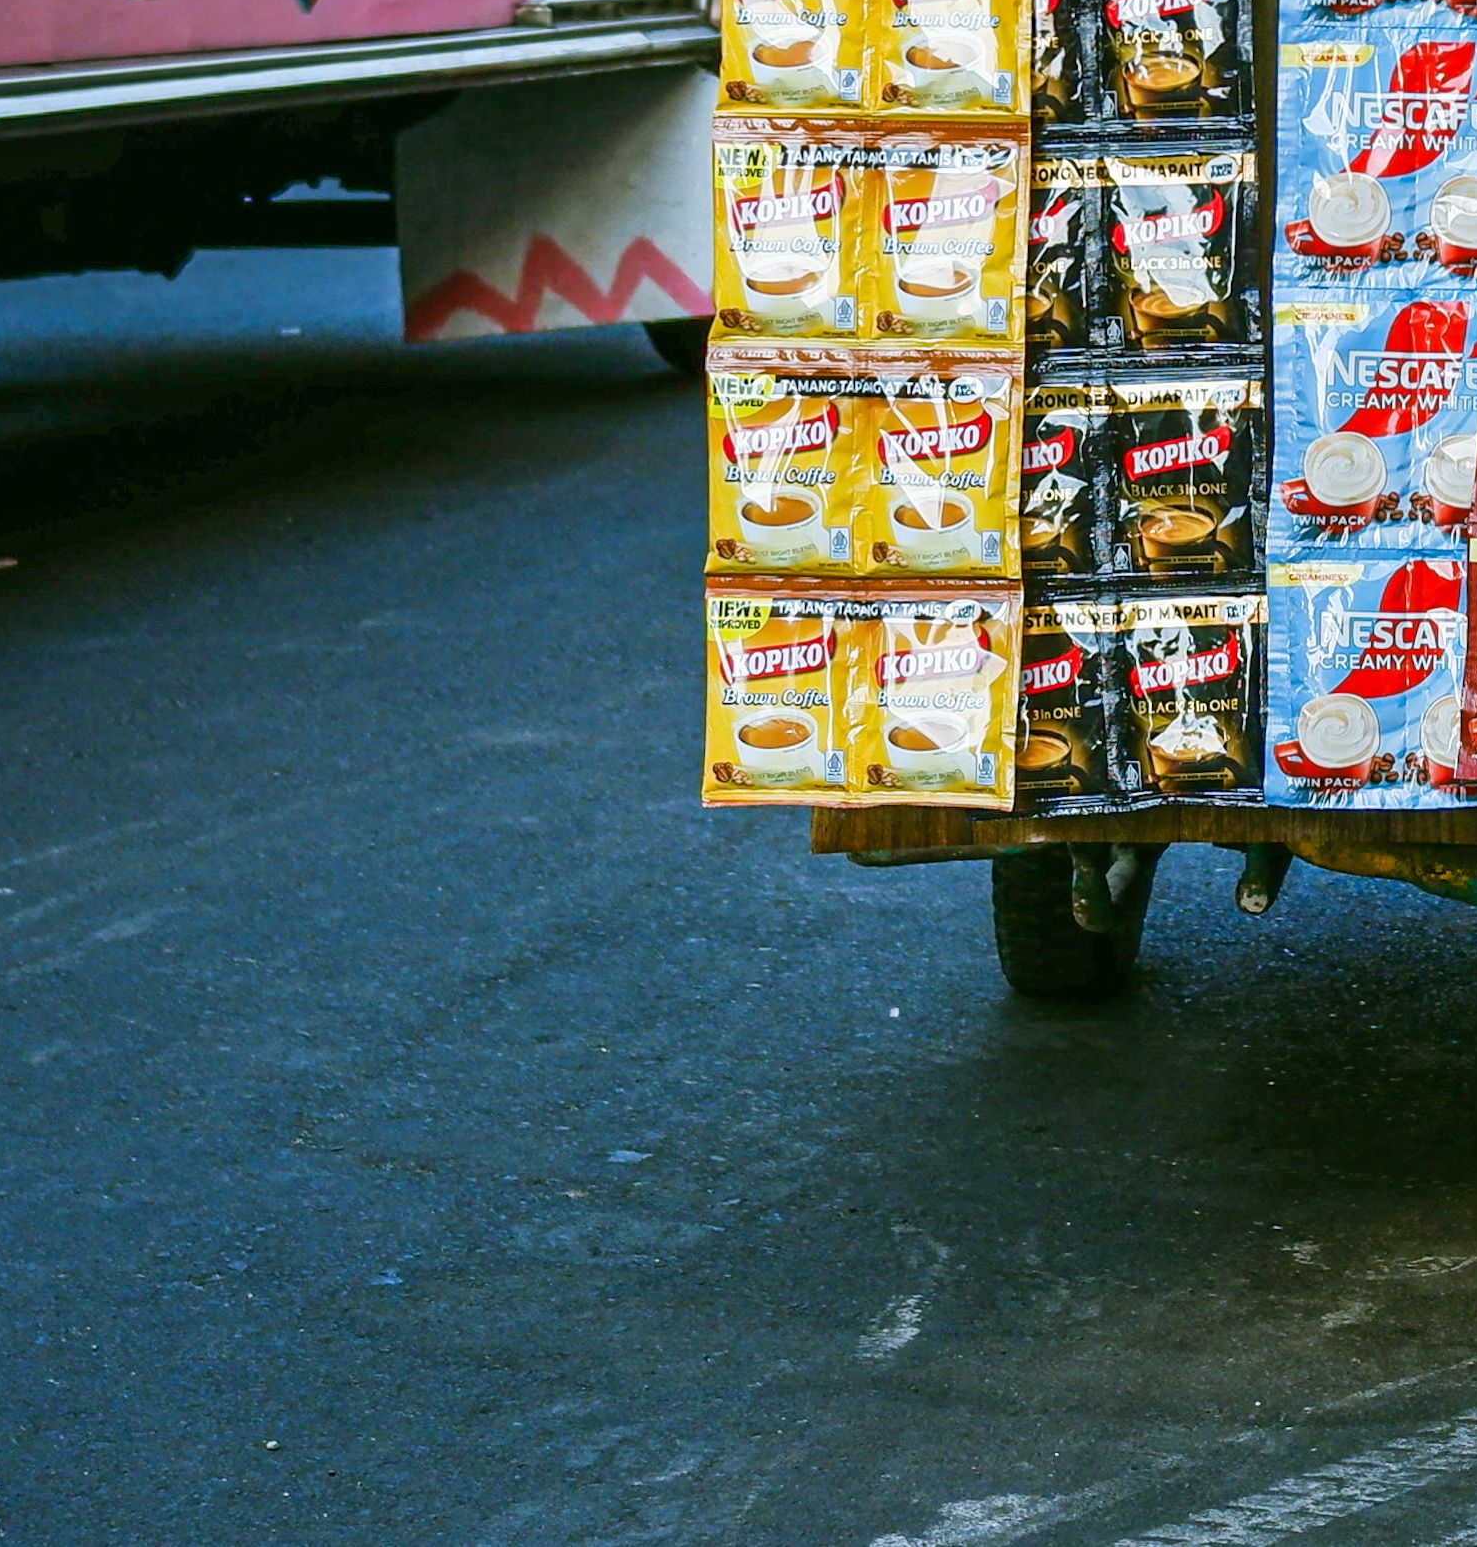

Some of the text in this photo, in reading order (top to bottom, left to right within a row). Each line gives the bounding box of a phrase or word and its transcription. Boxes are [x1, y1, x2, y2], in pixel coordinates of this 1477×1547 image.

[1331, 133, 1416, 151] CREAMY
[739, 191, 833, 225] KOPIKO
[892, 194, 985, 228] KOPIKO
[1123, 209, 1212, 246] KOPIKO
[781, 378, 839, 393] TAMANG
[1149, 388, 1208, 404] MAPAIT
[1327, 392, 1408, 409] CREAMY
[733, 421, 826, 456] KOPIKO
[888, 424, 981, 459] KOPIKO
[1132, 435, 1219, 476] KOPIKO
[725, 464, 835, 486] Brown Coffee
[1130, 483, 1175, 497] BLACK
[1199, 482, 1227, 496] ONE
[901, 603, 942, 616] TAMIS
[1321, 612, 1467, 650] NESCAF
[731, 642, 824, 678] KOPIKO
[882, 645, 976, 681] KOPIKO
[1140, 651, 1229, 691] KOPIKO
[1322, 652, 1464, 670] CREAMY WHIT
[723, 689, 831, 708] Brown Coffee
